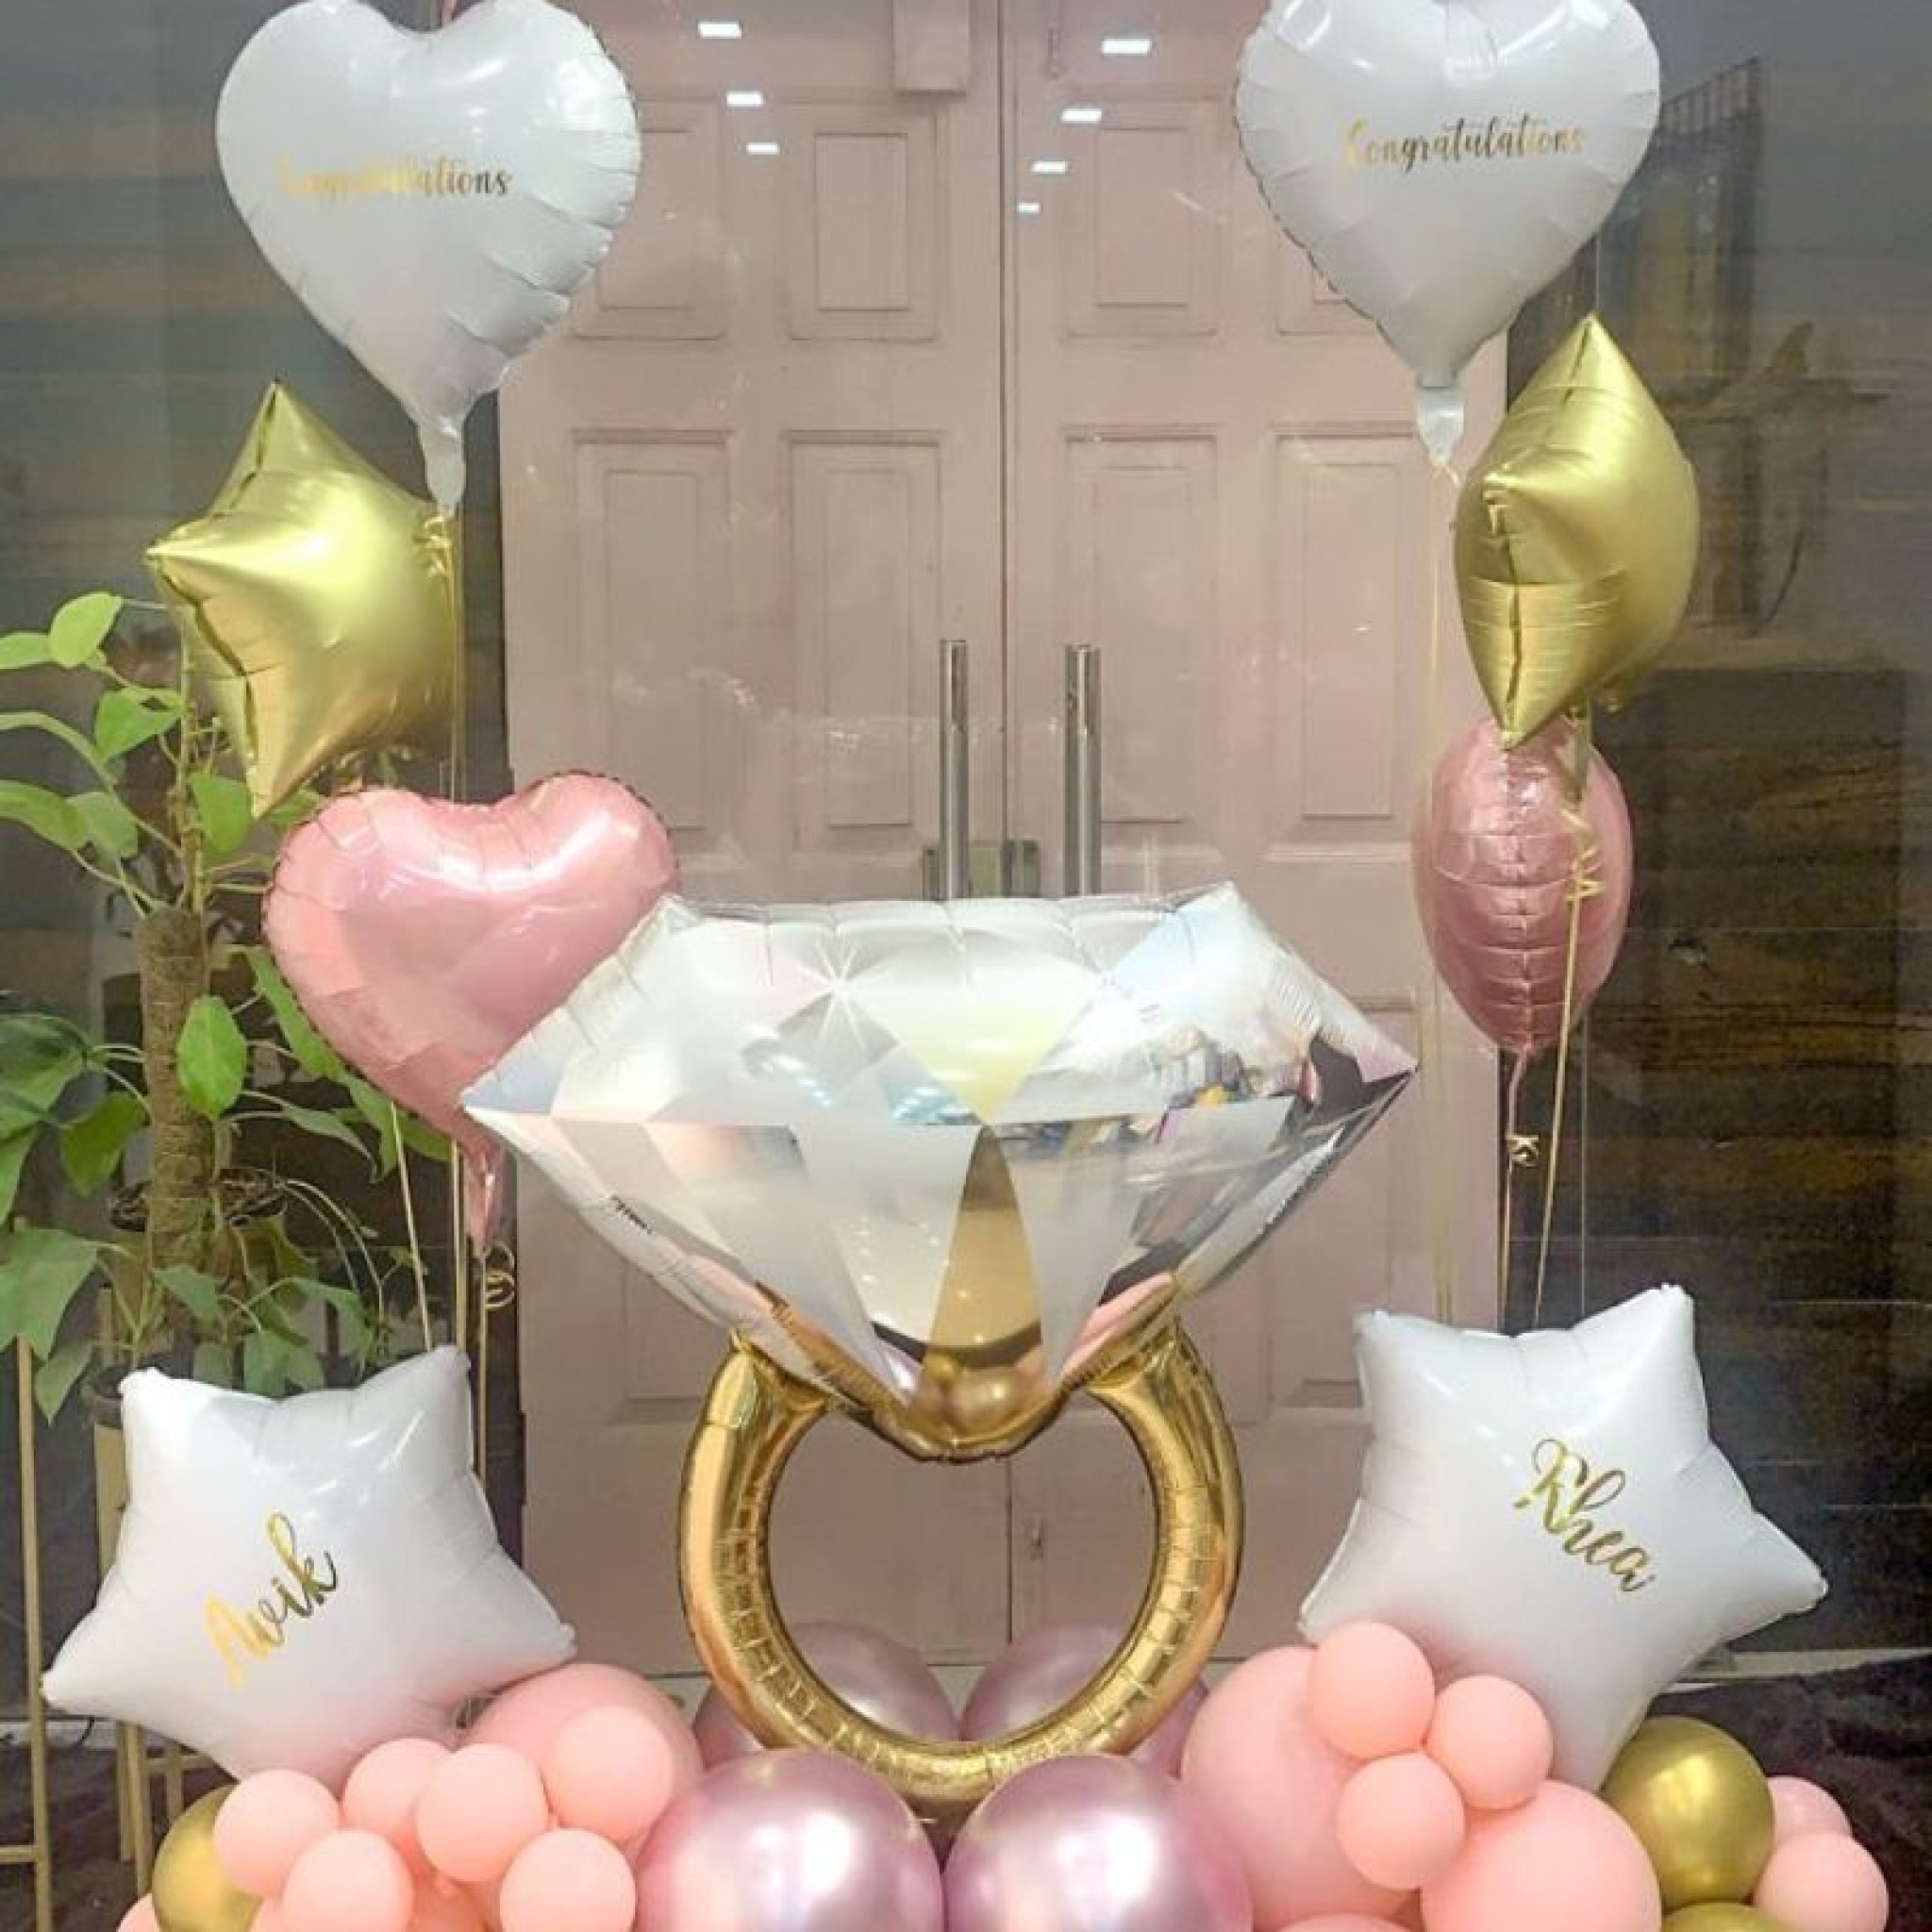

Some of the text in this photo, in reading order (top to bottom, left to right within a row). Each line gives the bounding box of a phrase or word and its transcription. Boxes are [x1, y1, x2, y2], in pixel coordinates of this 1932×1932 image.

[273, 153, 512, 204] Cnglations
[1346, 112, 1585, 174] Congratulations
[1513, 1438, 1657, 1591] Rhea
[205, 1511, 338, 1691] Avik
